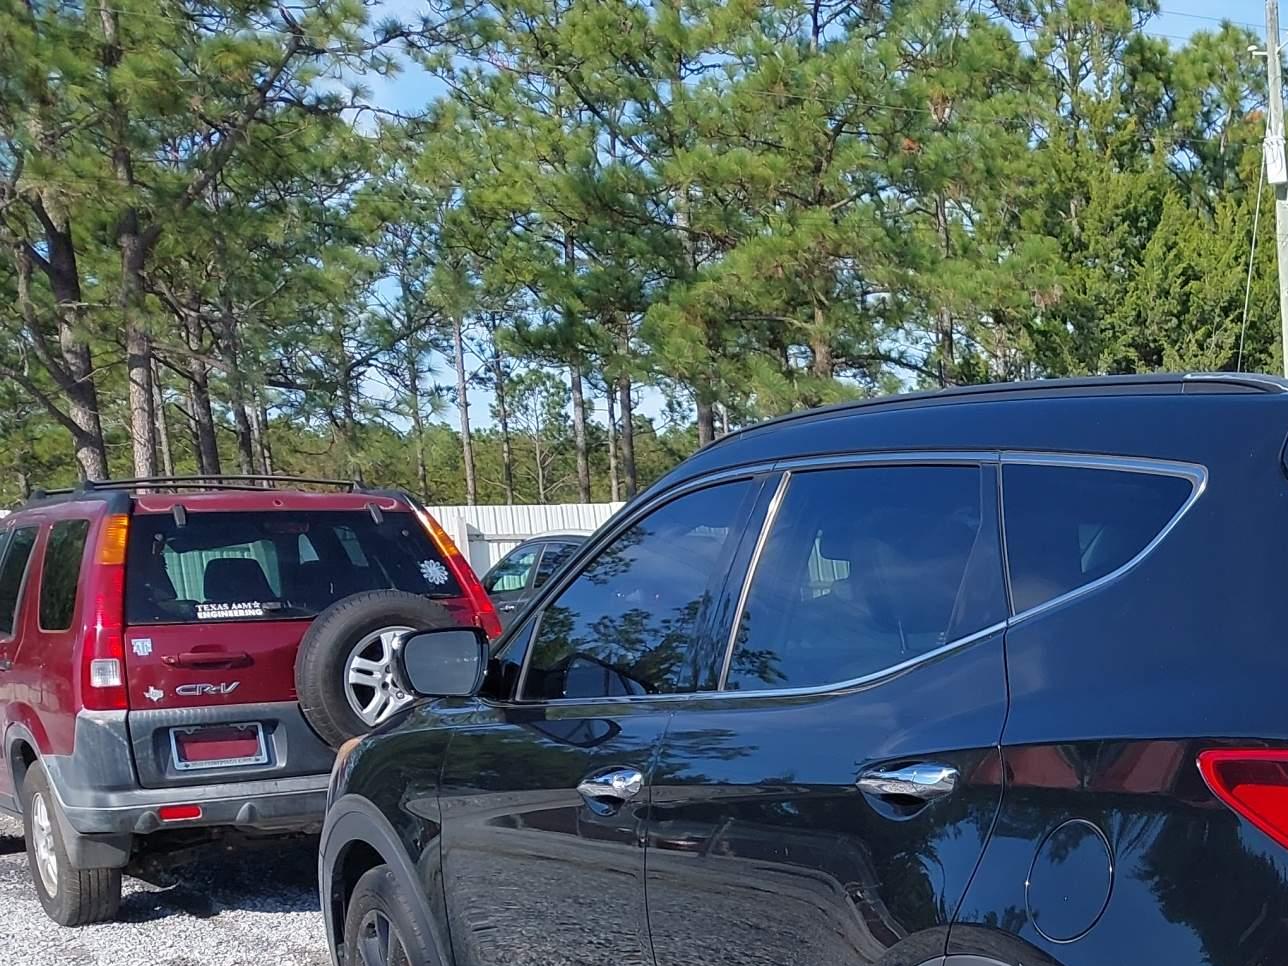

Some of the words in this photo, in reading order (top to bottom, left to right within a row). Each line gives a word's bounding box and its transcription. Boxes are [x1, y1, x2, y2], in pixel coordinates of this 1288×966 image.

[195, 603, 229, 612] TEXAS
[197, 608, 263, 619] ENGINEERING
[175, 681, 240, 696] CR-V
